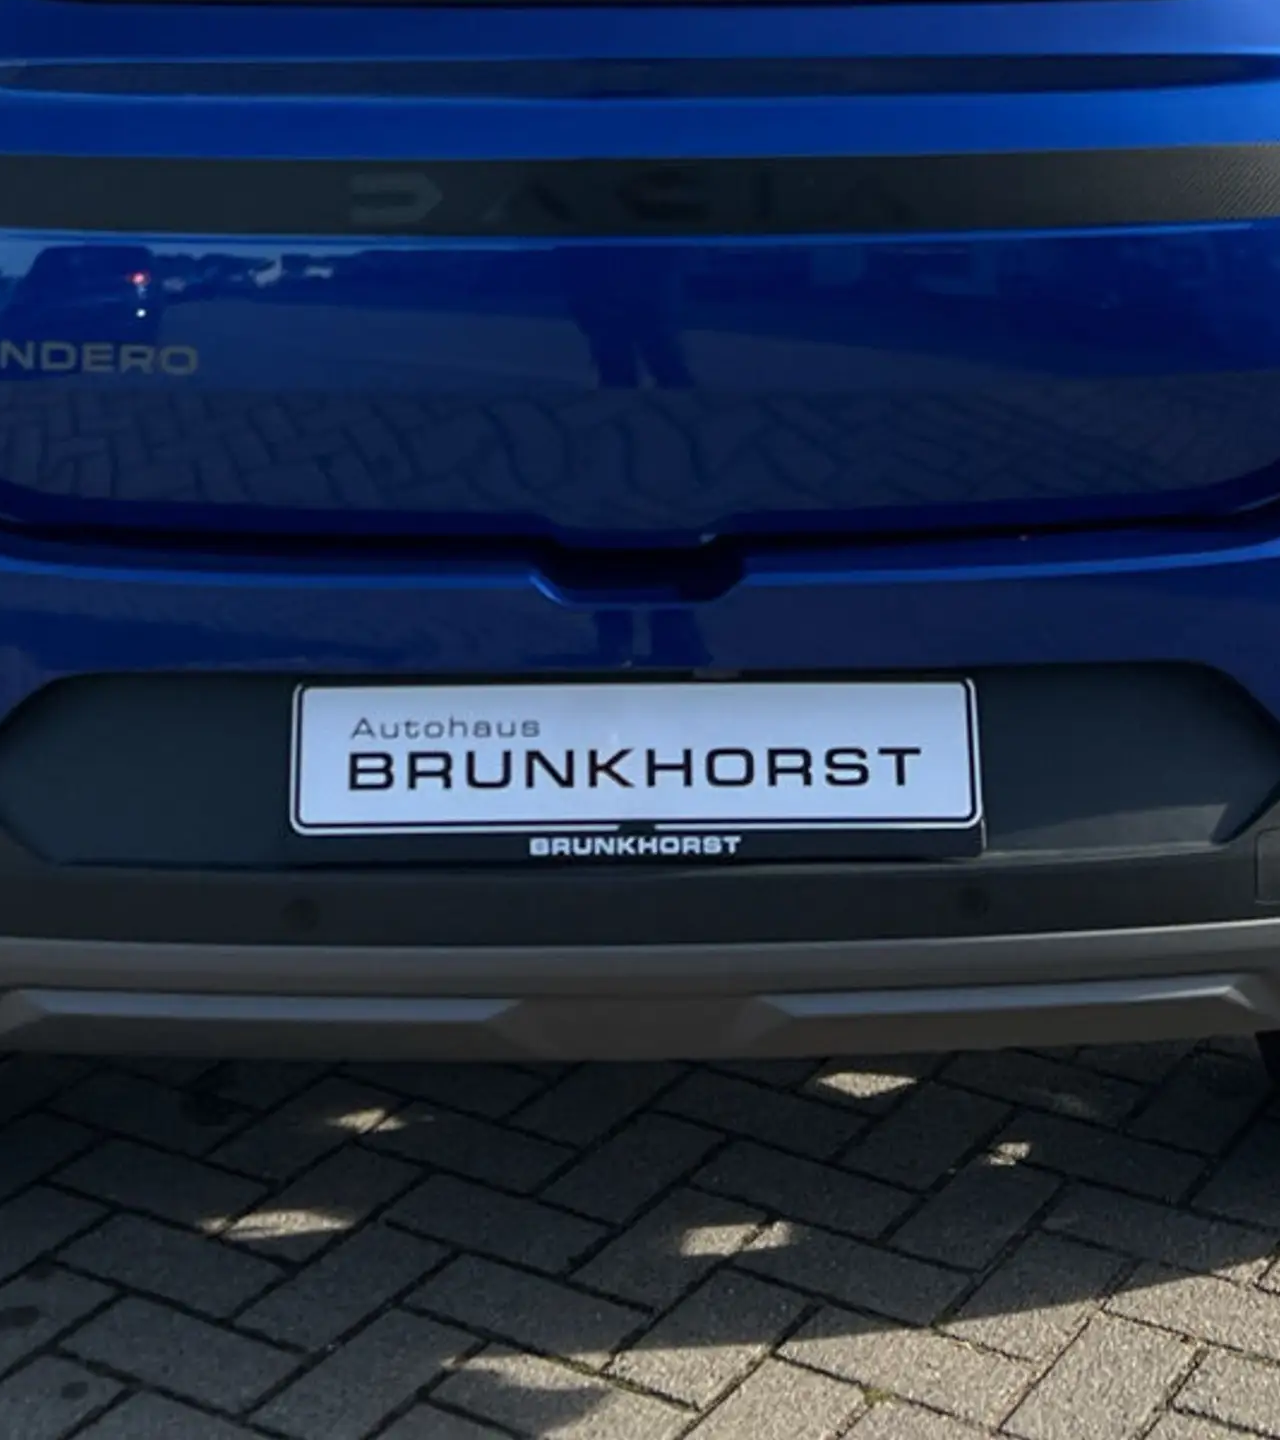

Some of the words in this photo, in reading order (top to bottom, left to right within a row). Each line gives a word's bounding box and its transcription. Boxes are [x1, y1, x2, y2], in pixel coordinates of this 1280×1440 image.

[350, 715, 542, 741] Autohaus
[348, 746, 923, 792] BRUNKHORST
[529, 835, 743, 857] BRUNKHORST
